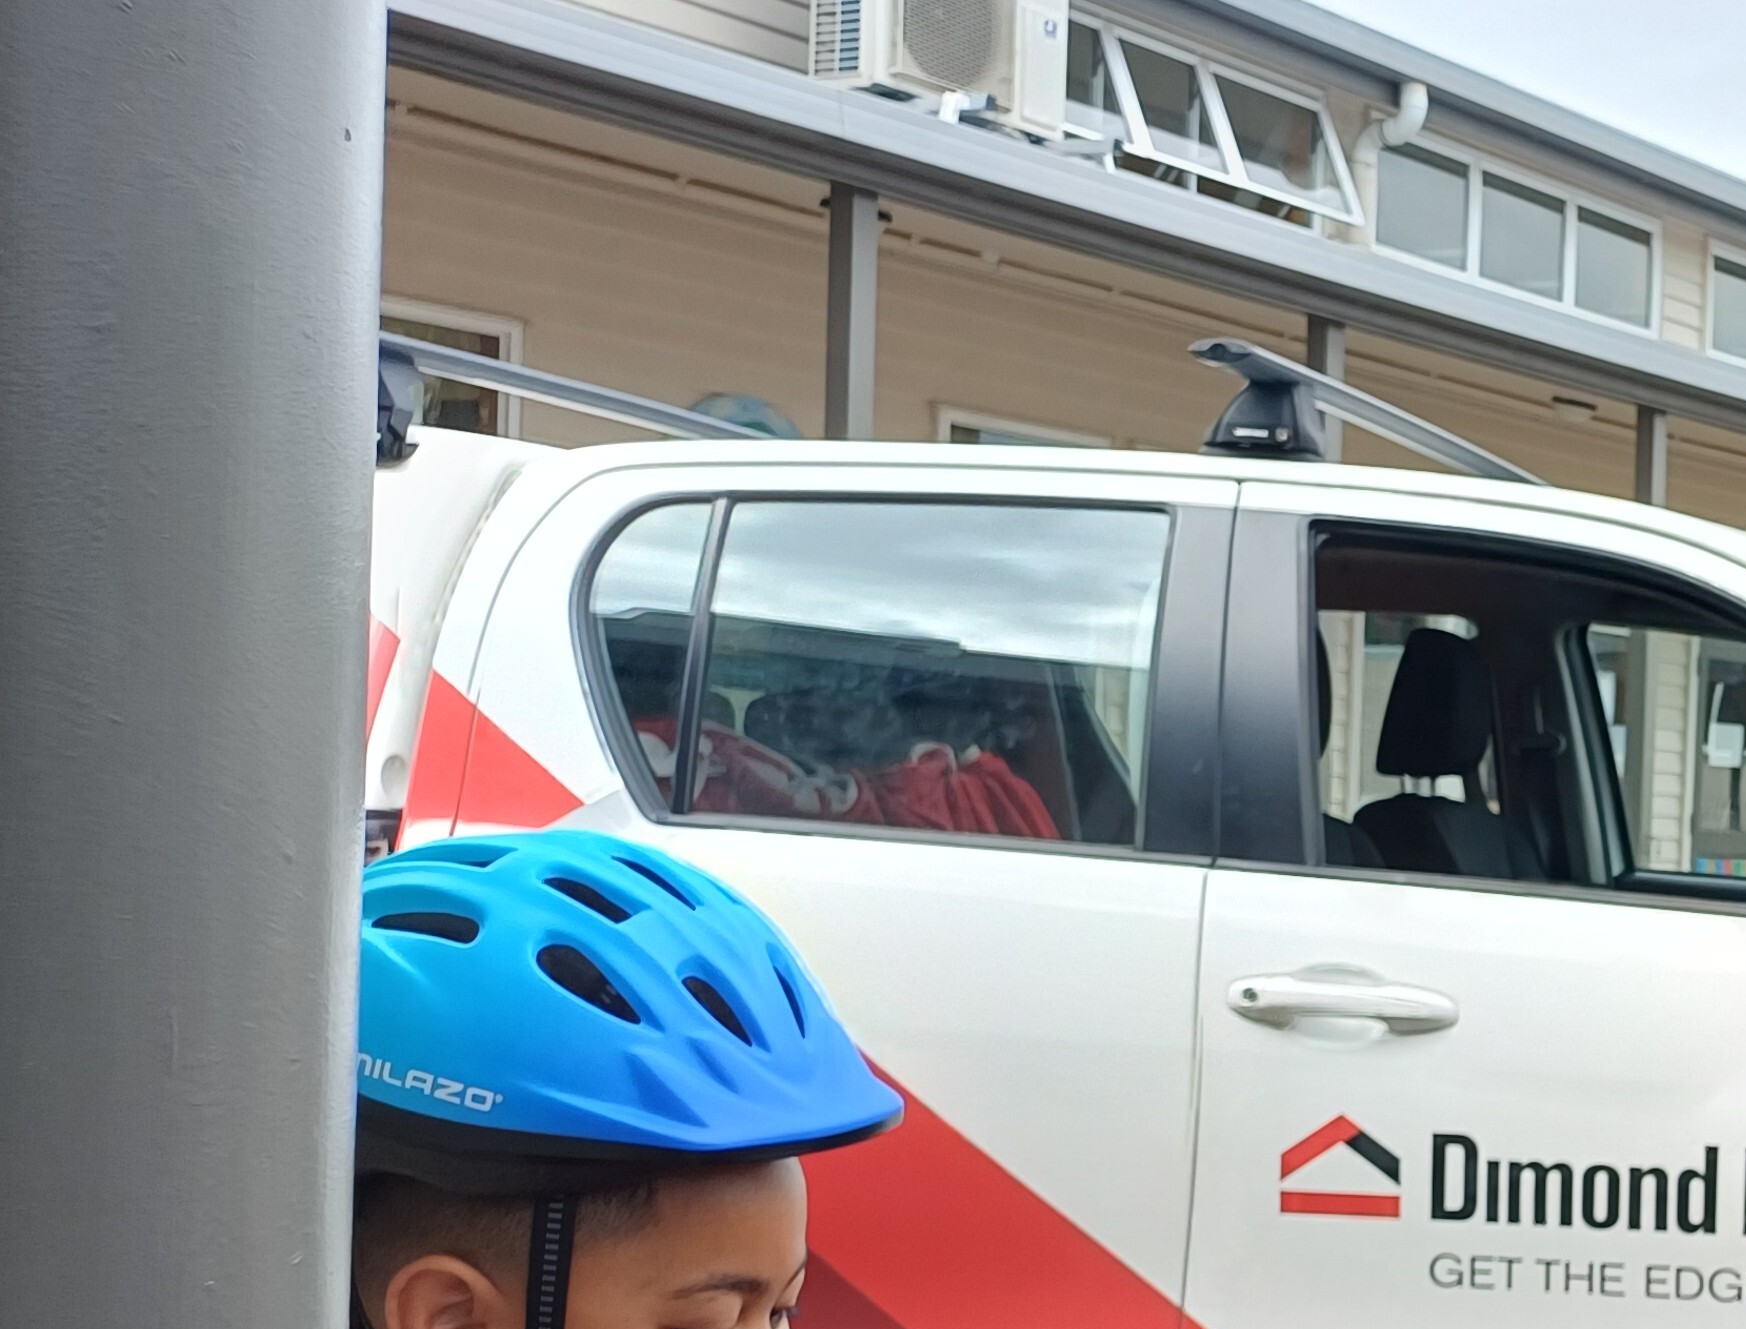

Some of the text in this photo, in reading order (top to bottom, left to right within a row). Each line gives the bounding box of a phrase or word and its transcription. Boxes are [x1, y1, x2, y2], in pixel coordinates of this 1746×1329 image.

[1430, 1132, 1719, 1235] Dimond
[1429, 1252, 1523, 1291] GET
[1535, 1258, 1627, 1298] THE
